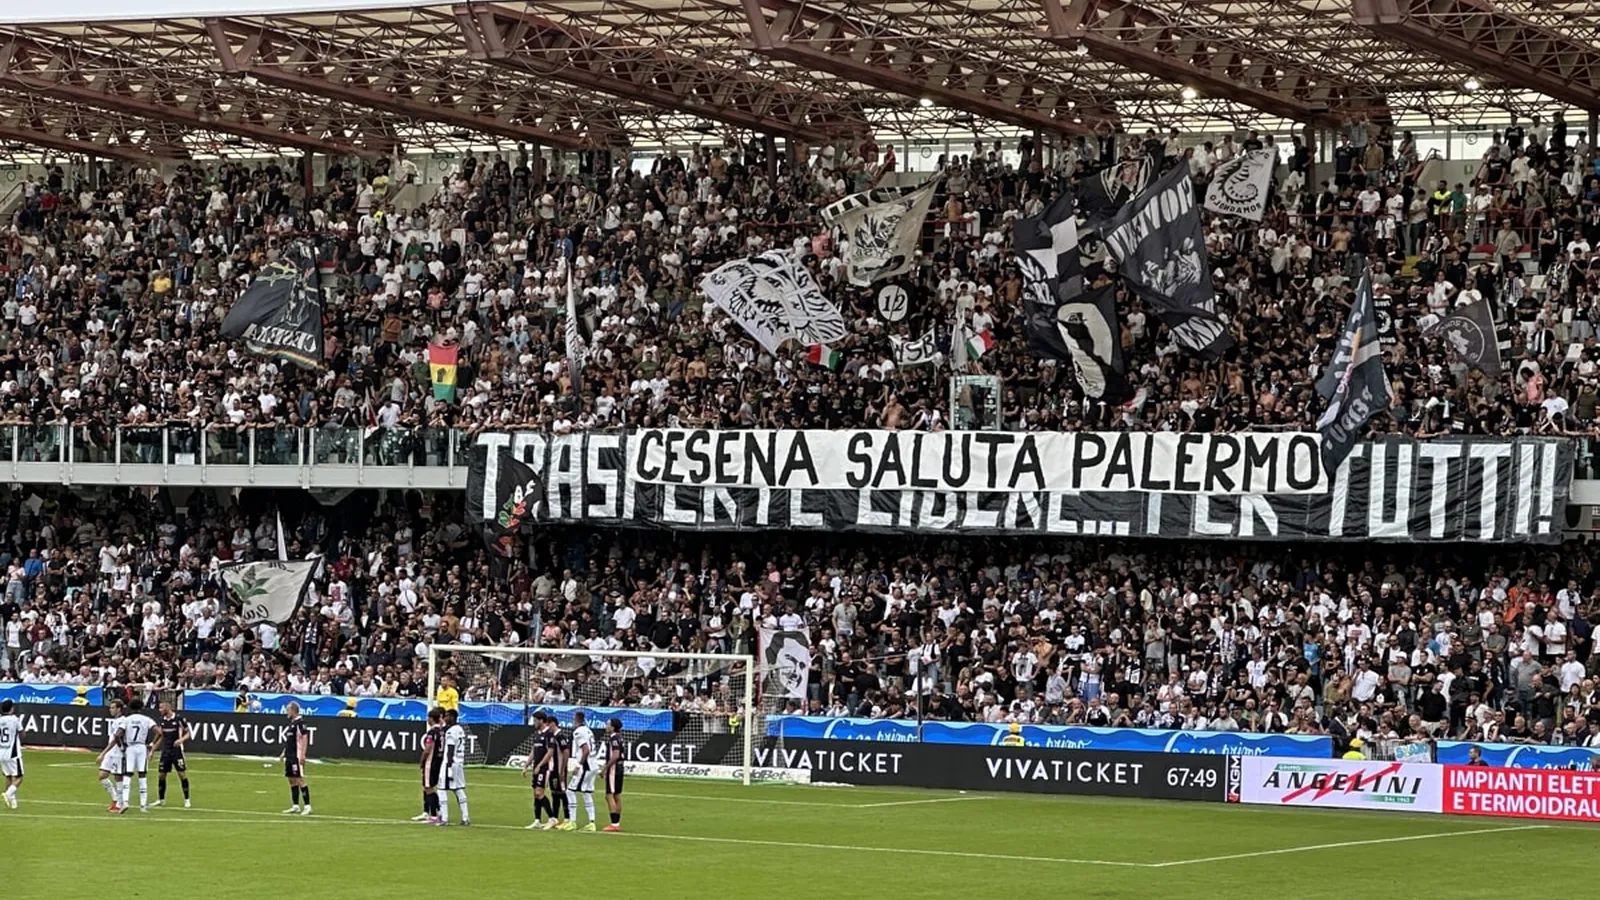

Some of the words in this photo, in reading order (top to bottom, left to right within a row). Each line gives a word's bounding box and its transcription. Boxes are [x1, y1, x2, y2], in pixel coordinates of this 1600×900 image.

[637, 429, 819, 487] CESENA
[847, 431, 1046, 488] SALUTA
[1072, 432, 1320, 491] PALERMO
[132, 725, 141, 742] 7
[187, 721, 317, 746] VIVATICKT
[657, 764, 712, 777] GoldBet
[754, 747, 902, 775] VIVATICKET
[986, 757, 1143, 785] VIVATICKET
[1167, 767, 1217, 788] 67:49
[1263, 771, 1422, 795] ANGELINI
[1450, 769, 1542, 792] IMPIANTI
[1453, 791, 1465, 810] E
